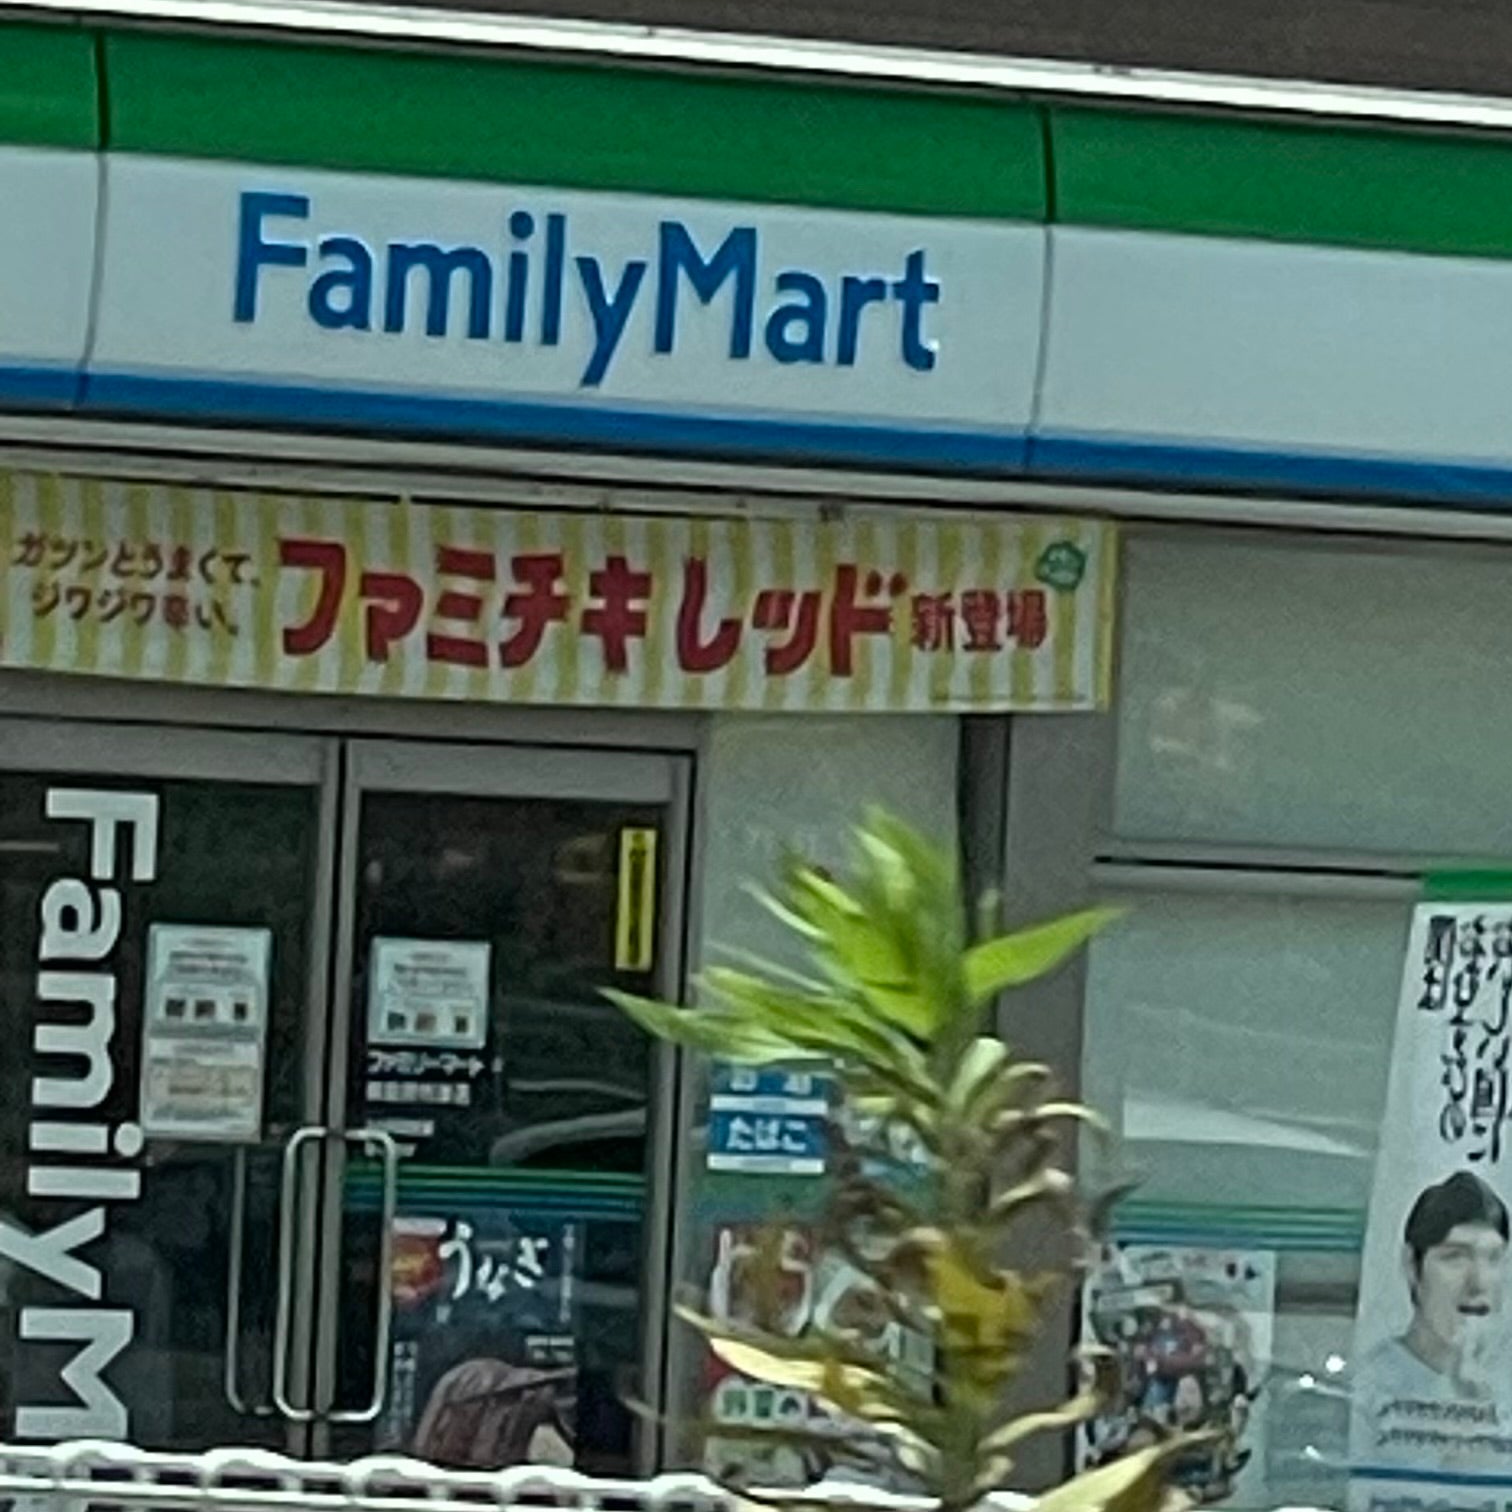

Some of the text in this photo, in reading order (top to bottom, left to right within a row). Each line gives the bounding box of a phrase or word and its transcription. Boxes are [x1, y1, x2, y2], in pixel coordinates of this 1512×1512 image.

[232, 191, 941, 388] FamilyMart
[276, 536, 1048, 678] ファミチキレッド 新登場
[0, 787, 160, 1512] FamilyM
[726, 1115, 808, 1153] たばこ
